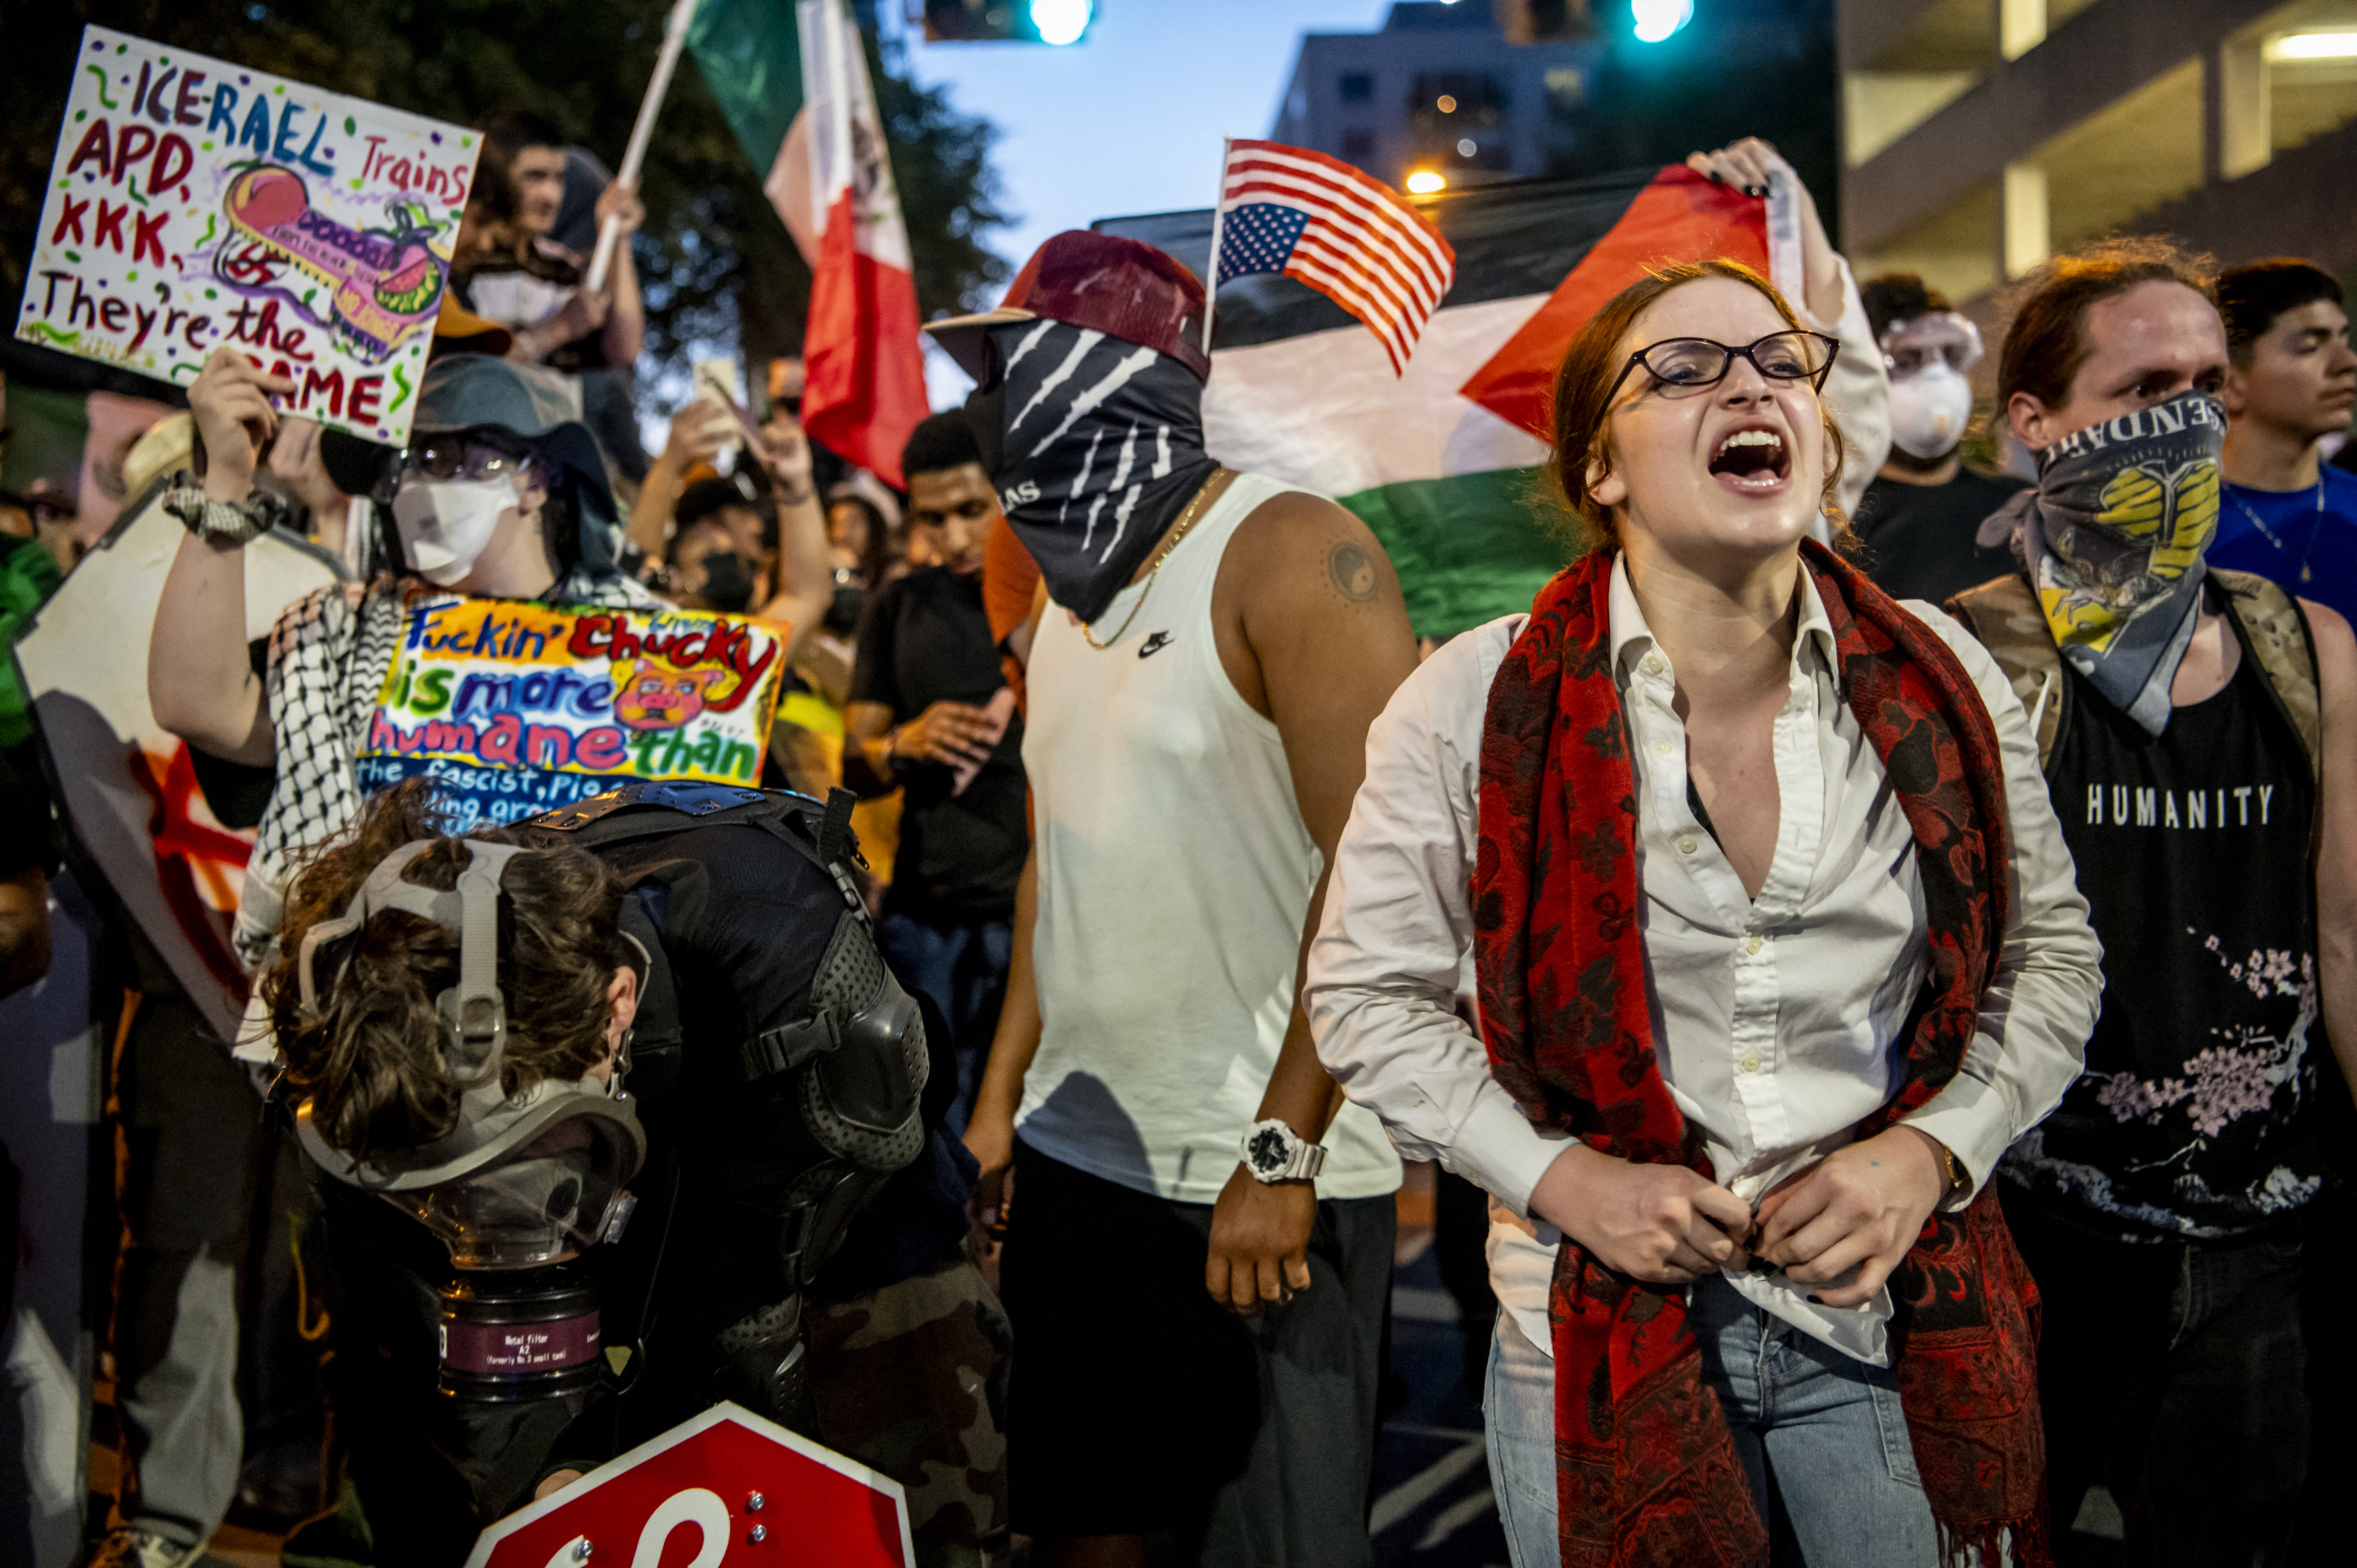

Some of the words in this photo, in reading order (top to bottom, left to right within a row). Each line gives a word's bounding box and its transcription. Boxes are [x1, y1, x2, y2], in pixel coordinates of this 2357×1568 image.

[362, 134, 468, 207] Trains
[39, 270, 210, 356] They're
[223, 298, 314, 362] the
[245, 353, 385, 427] AME
[394, 660, 455, 716] is
[452, 667, 616, 719] more
[405, 601, 565, 660] Fuckin'
[568, 613, 777, 712] Chucky
[356, 758, 403, 783] the
[369, 705, 627, 769] humane
[628, 728, 760, 779] than
[2087, 783, 2274, 829] HUMANITY
[519, 1344, 530, 1356] A2
